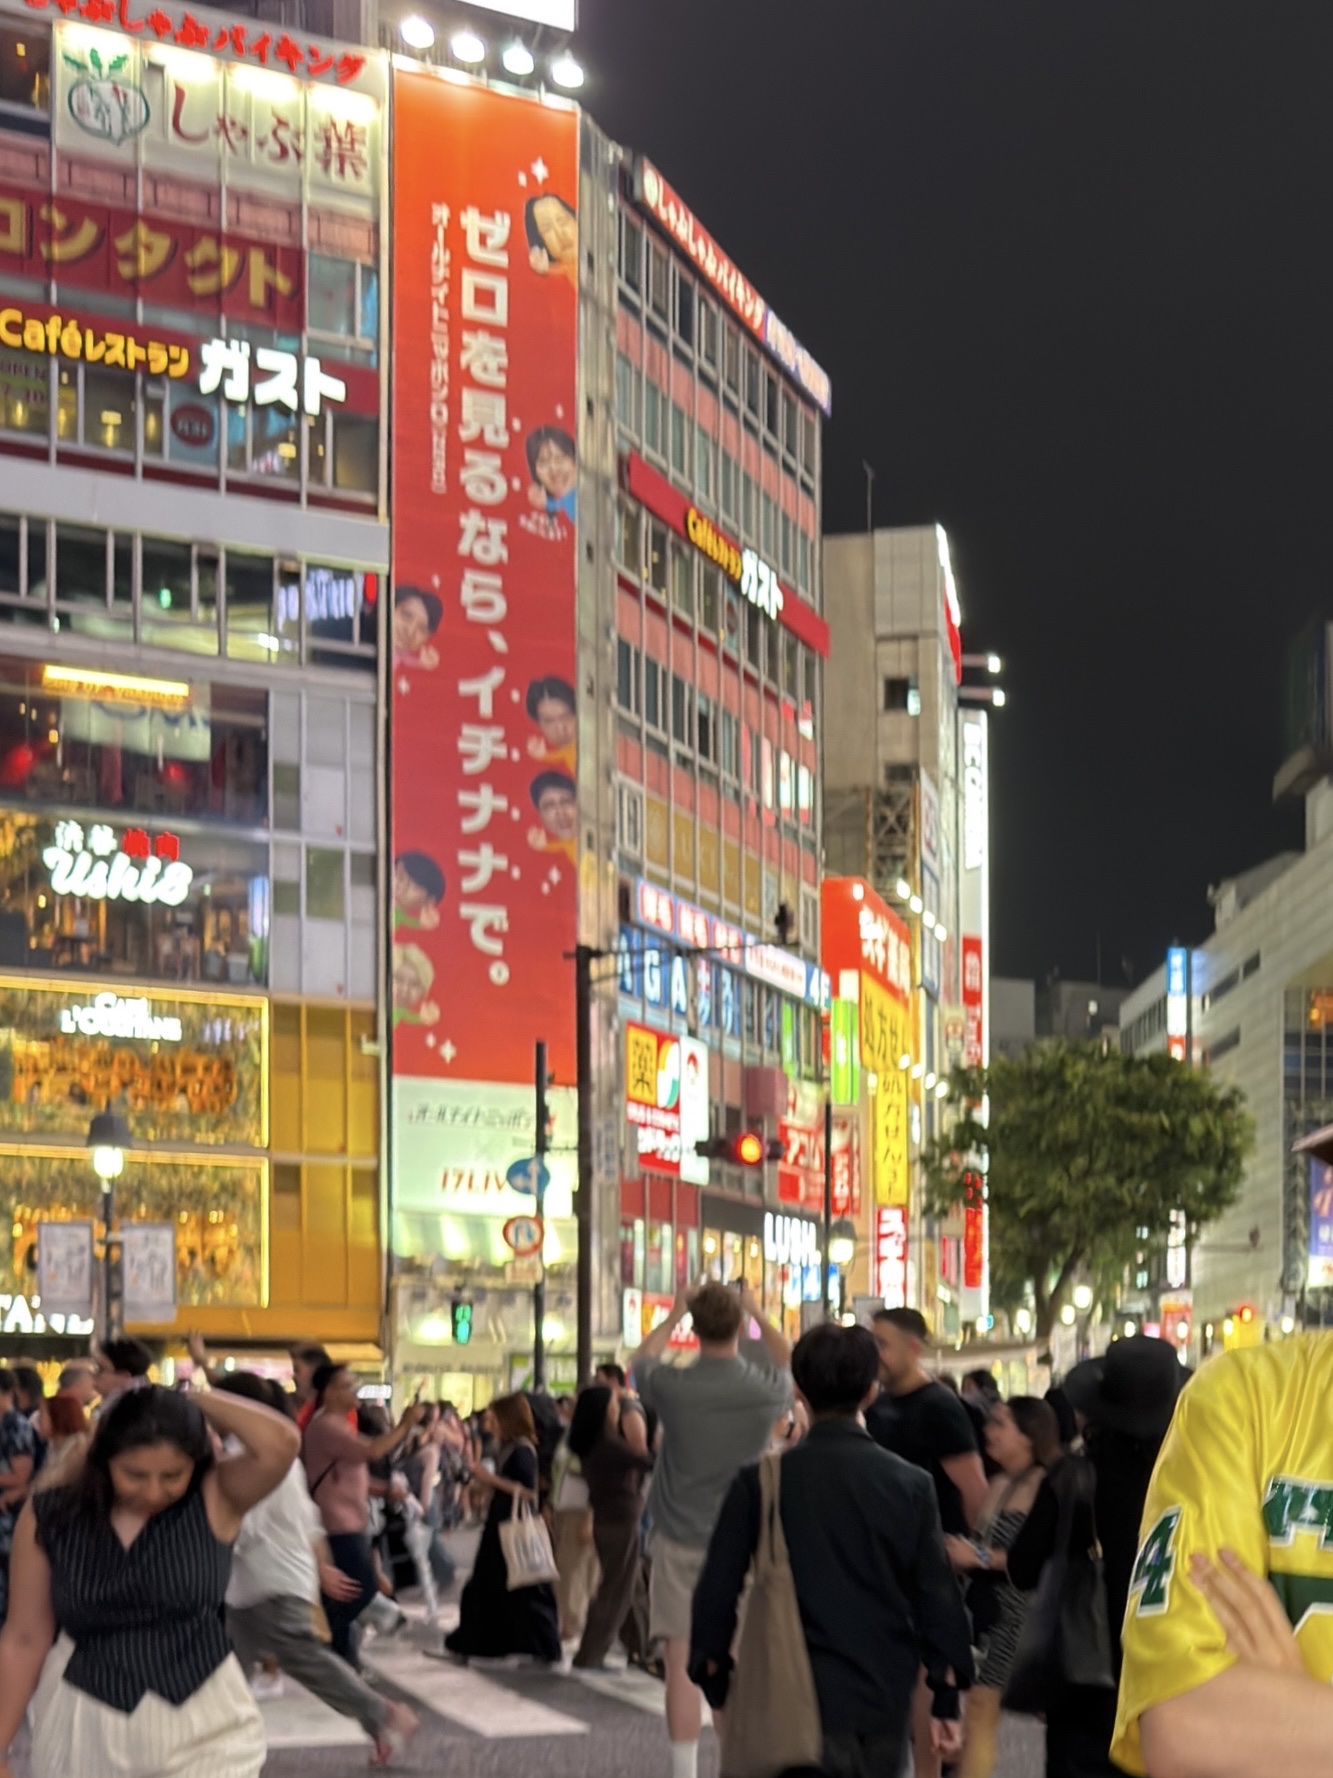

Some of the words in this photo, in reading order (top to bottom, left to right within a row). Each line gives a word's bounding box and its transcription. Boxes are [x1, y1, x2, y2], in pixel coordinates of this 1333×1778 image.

[25, 0, 366, 86] ぶしゃぶバイキング
[199, 336, 346, 417] ガスト
[457, 204, 511, 986] ゼロを見るなら、イチナナで。
